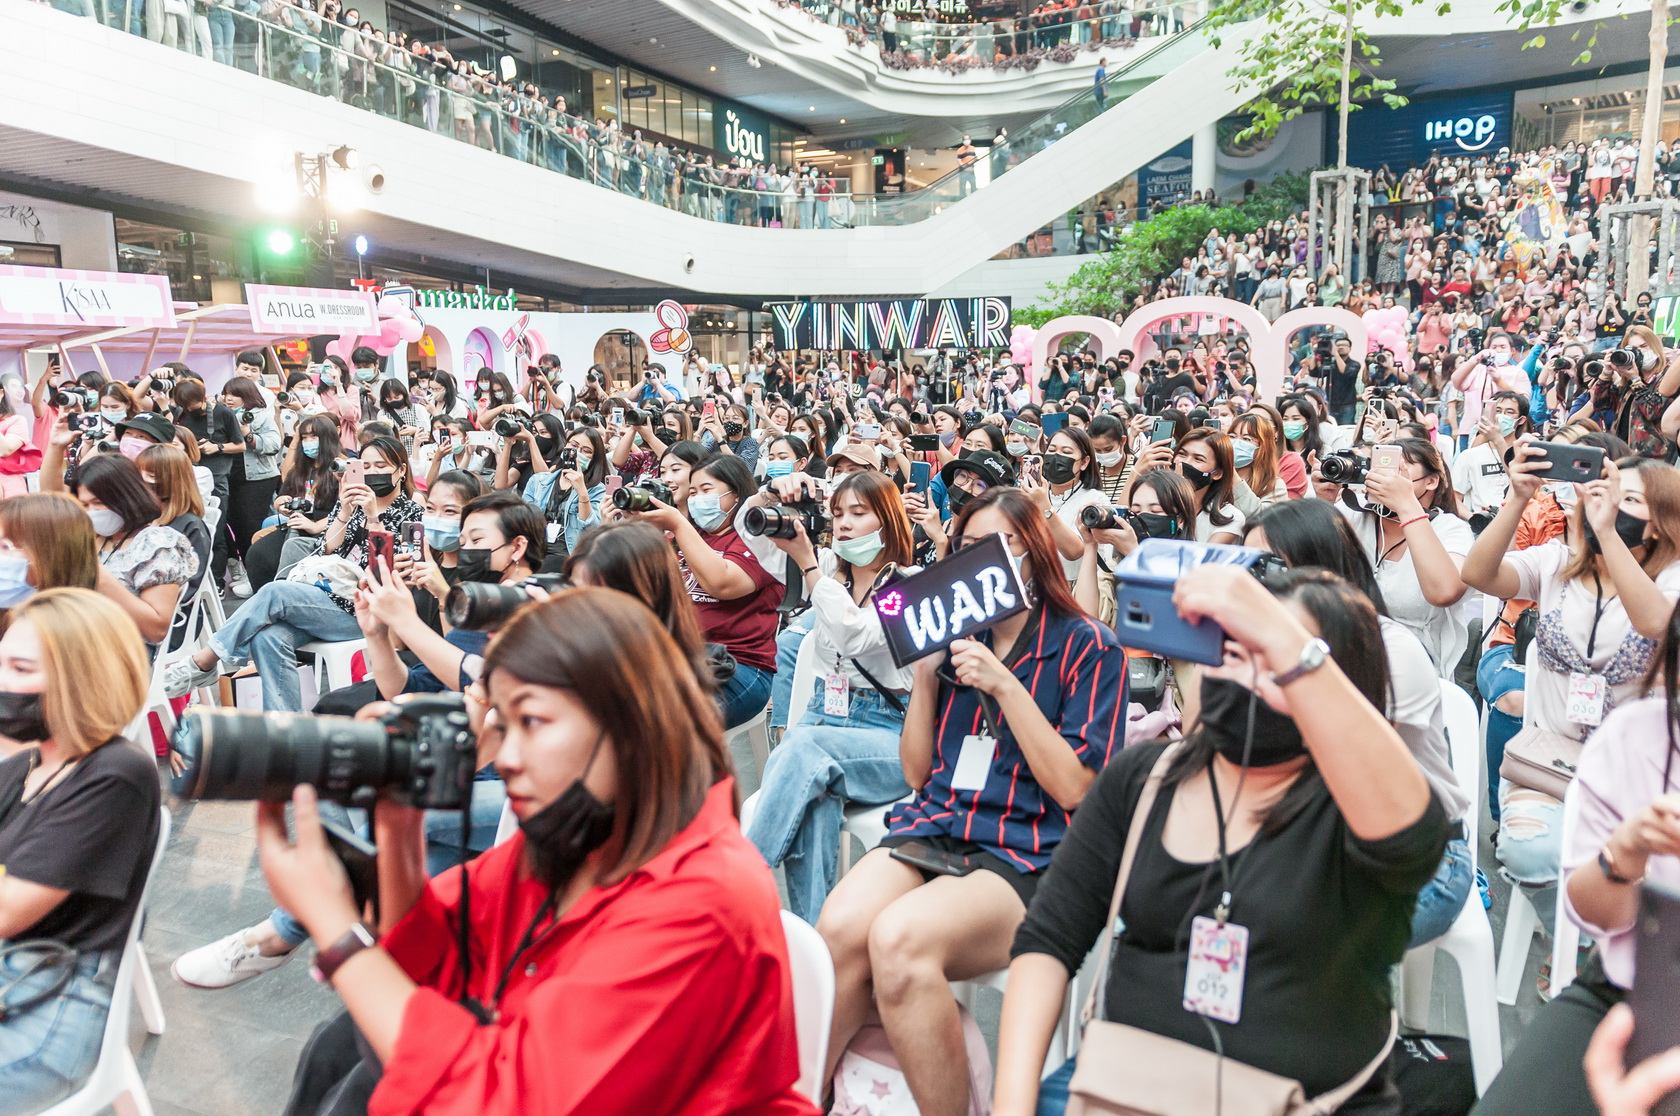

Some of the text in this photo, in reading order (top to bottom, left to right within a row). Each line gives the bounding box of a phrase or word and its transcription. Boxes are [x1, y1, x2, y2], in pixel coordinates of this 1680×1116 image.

[1425, 114, 1496, 142] IHOP
[417, 284, 519, 311] market
[772, 297, 1010, 350] YINWAR
[903, 565, 1016, 651] WAR
[828, 698, 843, 707] 023
